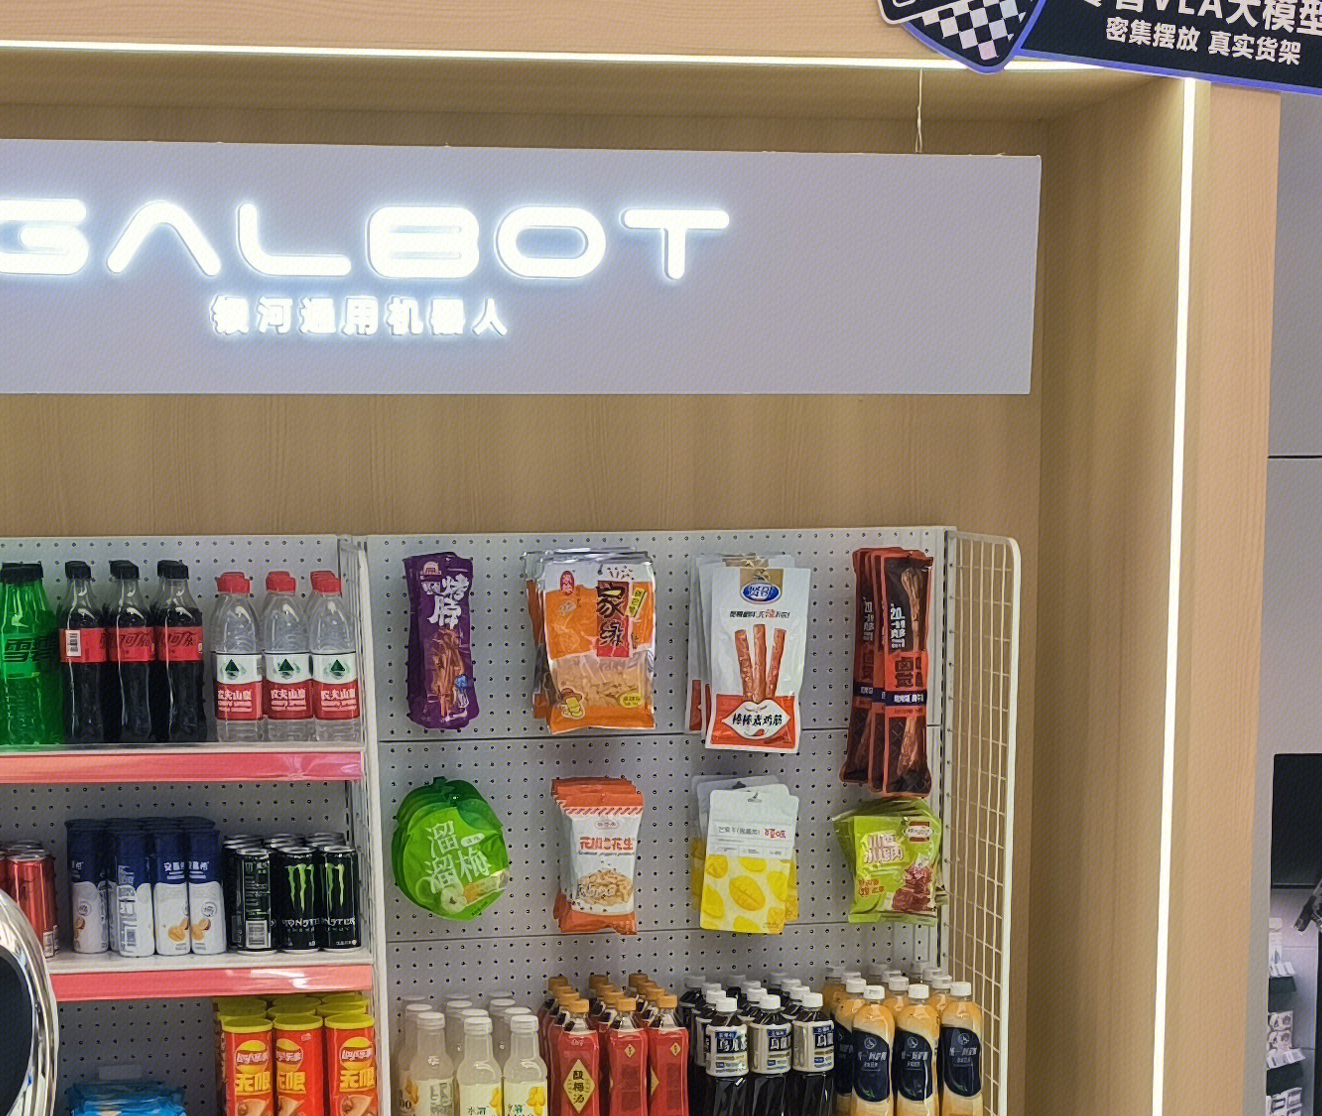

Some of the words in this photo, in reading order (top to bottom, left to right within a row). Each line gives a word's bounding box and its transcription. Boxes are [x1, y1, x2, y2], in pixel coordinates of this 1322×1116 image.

[1105, 16, 1201, 52] 密集摆放
[1207, 30, 1302, 66] 真实货架
[209, 295, 509, 336] 银河通用机器人
